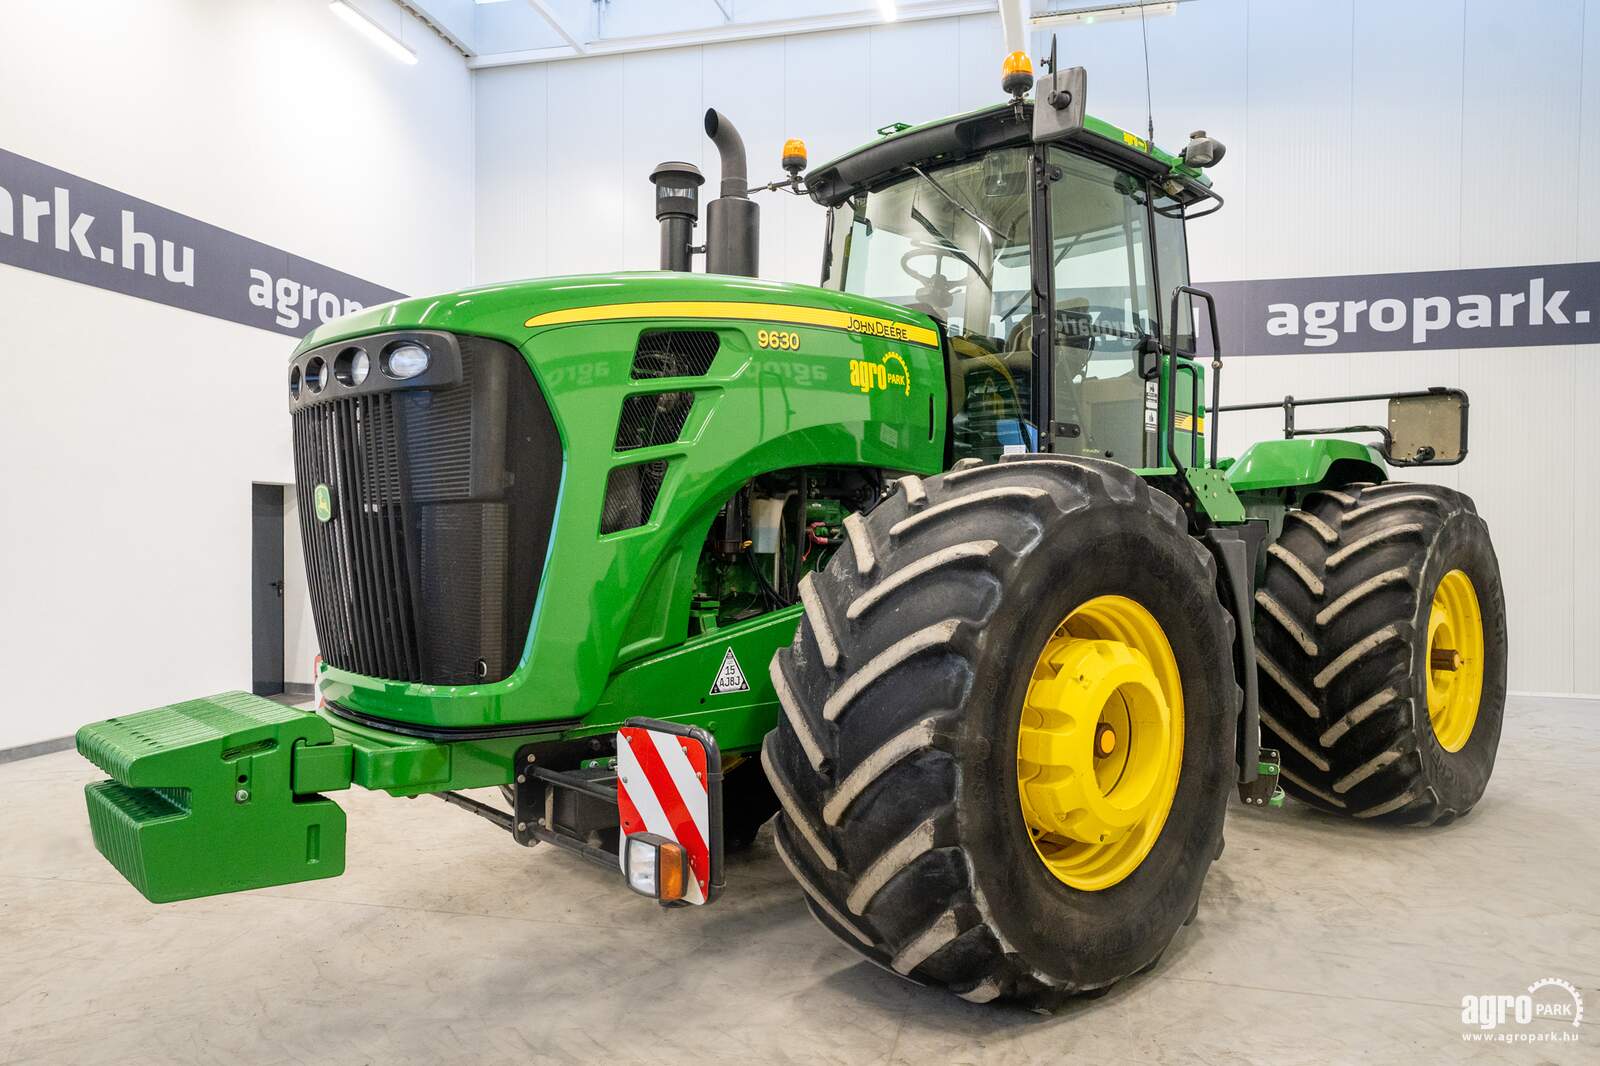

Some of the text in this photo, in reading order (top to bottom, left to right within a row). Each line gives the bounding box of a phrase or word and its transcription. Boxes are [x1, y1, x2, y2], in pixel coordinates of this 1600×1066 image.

[1266, 278, 1591, 347] agropark.
[847, 316, 908, 340] JOHN DEERE
[758, 330, 800, 351] 9630
[849, 359, 905, 393] agro PARK
[725, 665, 735, 676] 15
